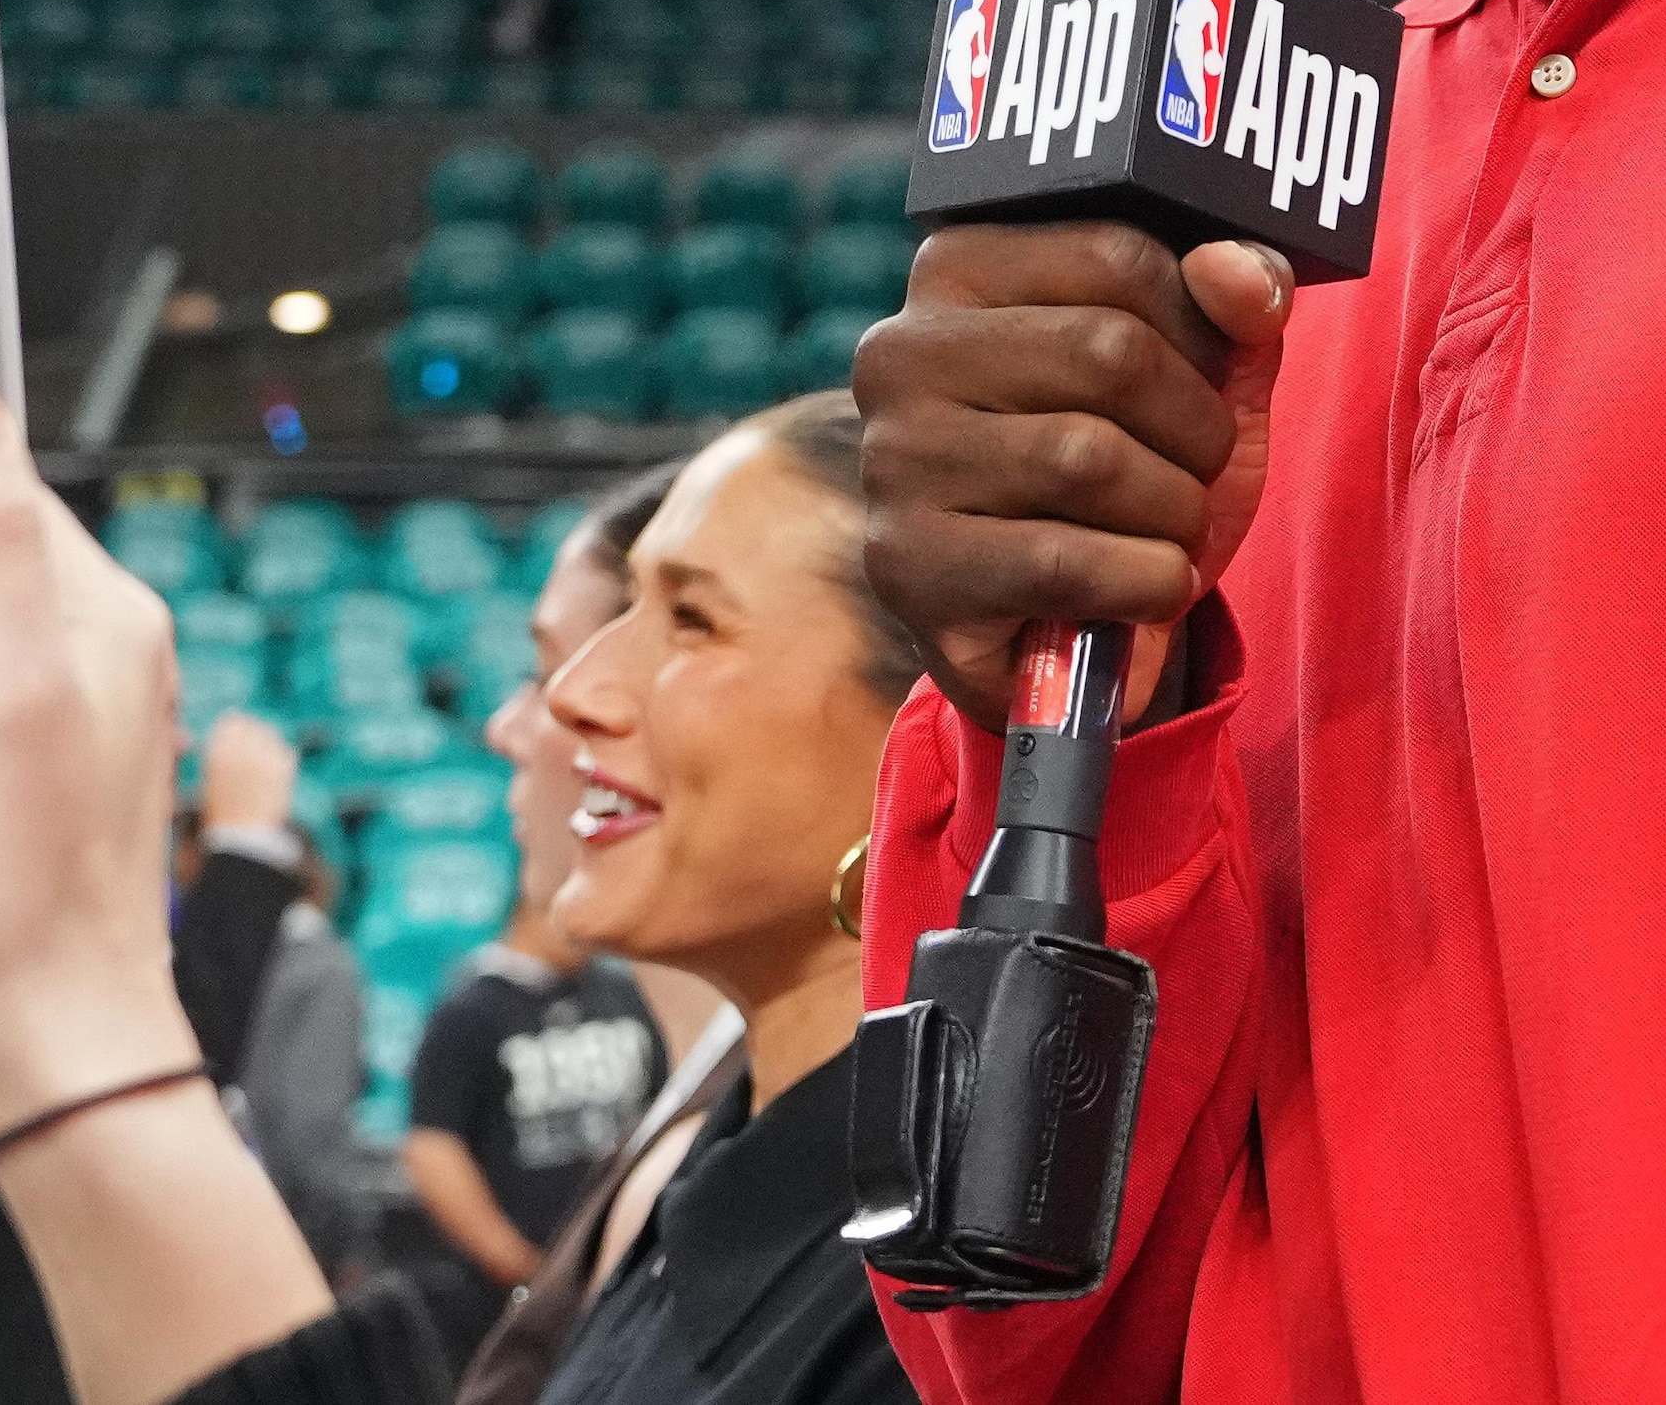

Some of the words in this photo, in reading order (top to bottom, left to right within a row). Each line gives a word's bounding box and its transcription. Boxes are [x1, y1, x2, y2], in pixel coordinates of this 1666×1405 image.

[936, 111, 963, 142] NBA
[1166, 92, 1195, 130] NBA
[1028, 691, 1040, 713] LLC
